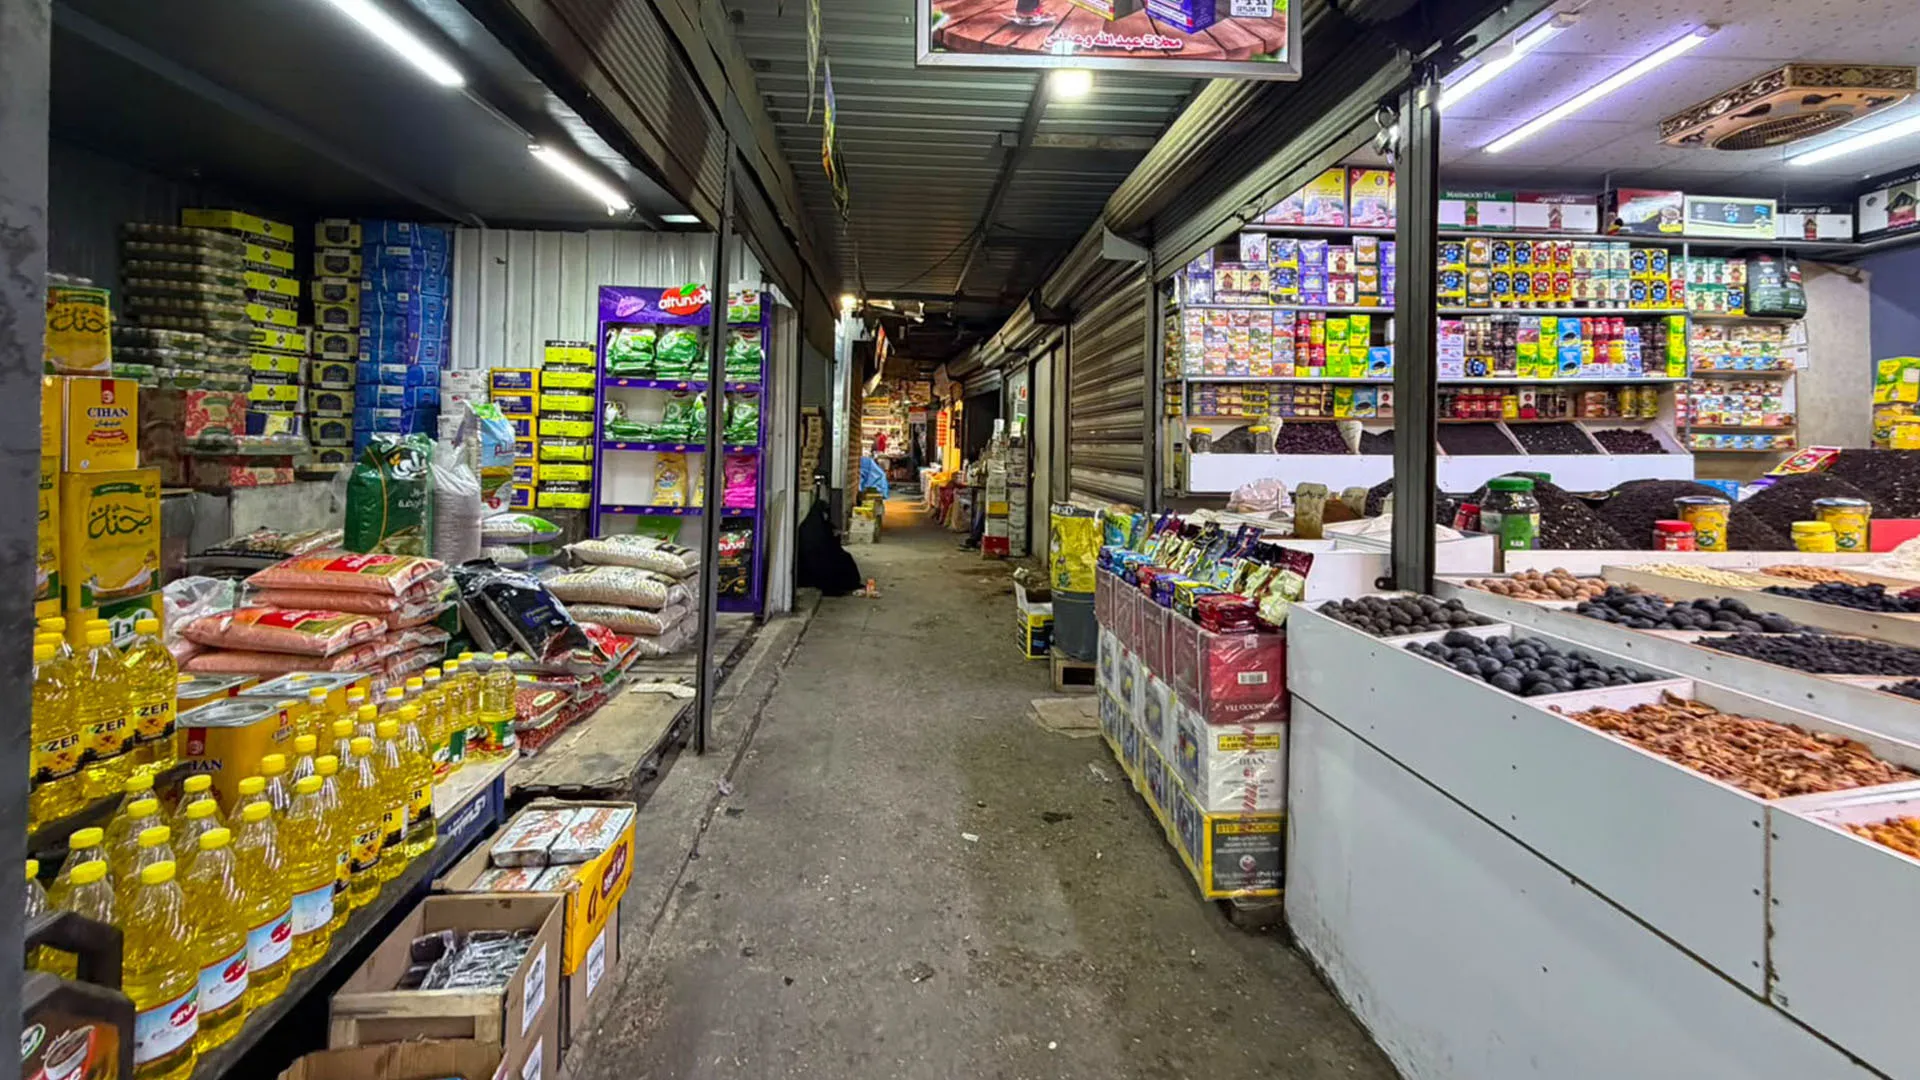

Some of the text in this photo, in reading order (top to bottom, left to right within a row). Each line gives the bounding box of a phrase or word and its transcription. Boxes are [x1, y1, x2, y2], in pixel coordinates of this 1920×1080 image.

[87, 407, 128, 418] CIHAN
[140, 702, 169, 717] ZER
[93, 718, 126, 734] ZER
[47, 734, 80, 752] ZER
